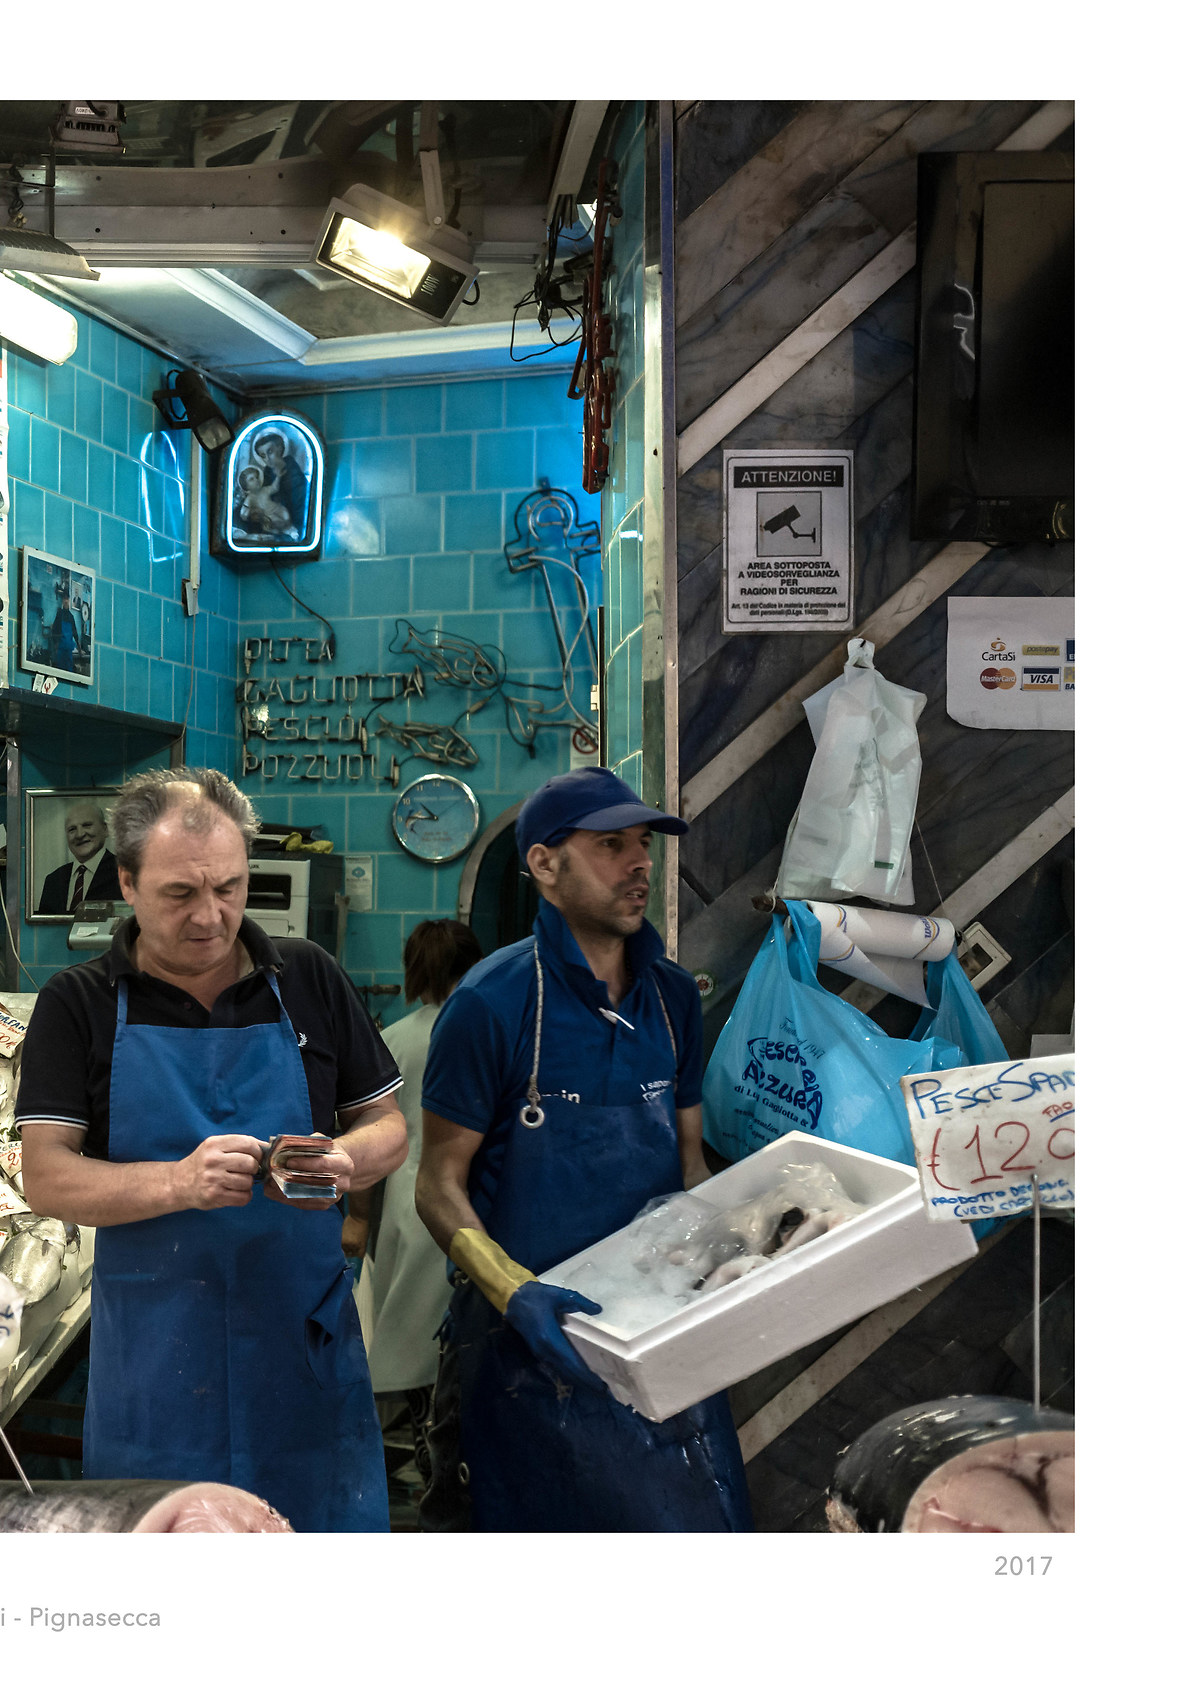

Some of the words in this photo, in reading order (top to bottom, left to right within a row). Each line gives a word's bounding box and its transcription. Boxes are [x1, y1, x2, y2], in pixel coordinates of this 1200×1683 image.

[741, 471, 837, 483] ATTENZIONE!
[747, 562, 772, 570] AREA
[774, 562, 831, 570] SOTTOPOSTA
[738, 571, 745, 579] A
[747, 570, 840, 579] VIDEOSORVEGLIANZA
[780, 579, 798, 587] PER
[740, 587, 777, 595] RAGIONI
[778, 587, 788, 595] DI
[789, 587, 837, 595] SICUREZZA
[981, 652, 1016, 661] CartaSi
[1030, 674, 1054, 684] VISA
[243, 753, 400, 782] POZZUOLI
[910, 1078, 1003, 1119] PESCE
